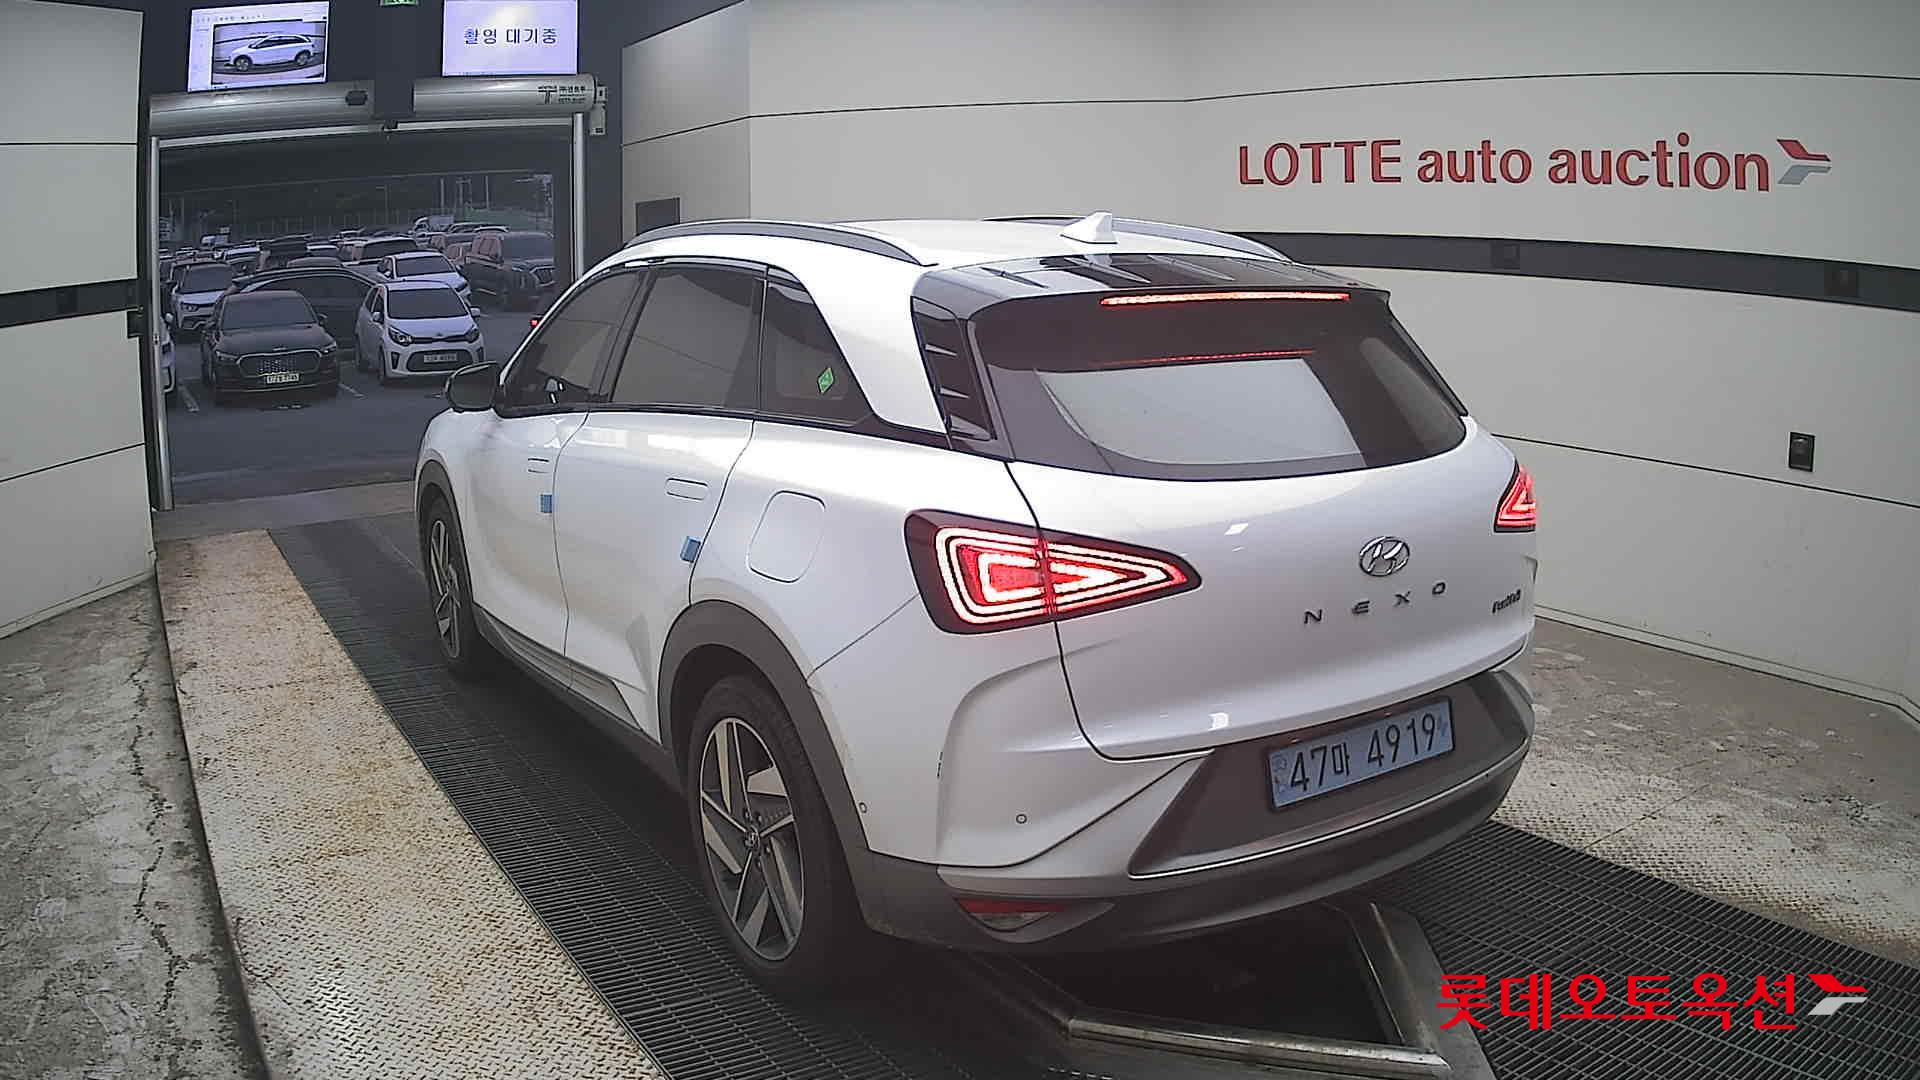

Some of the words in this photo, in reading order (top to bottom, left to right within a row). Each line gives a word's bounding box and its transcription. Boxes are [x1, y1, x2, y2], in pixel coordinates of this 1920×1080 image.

[506, 28, 558, 45] 대기중
[1240, 139, 1402, 186] LOTTE
[1417, 139, 1532, 185] auto
[1548, 133, 1770, 192] auction
[1303, 582, 1446, 624] NEXO
[1290, 743, 1350, 792] 47마
[1367, 713, 1437, 767] 4919
